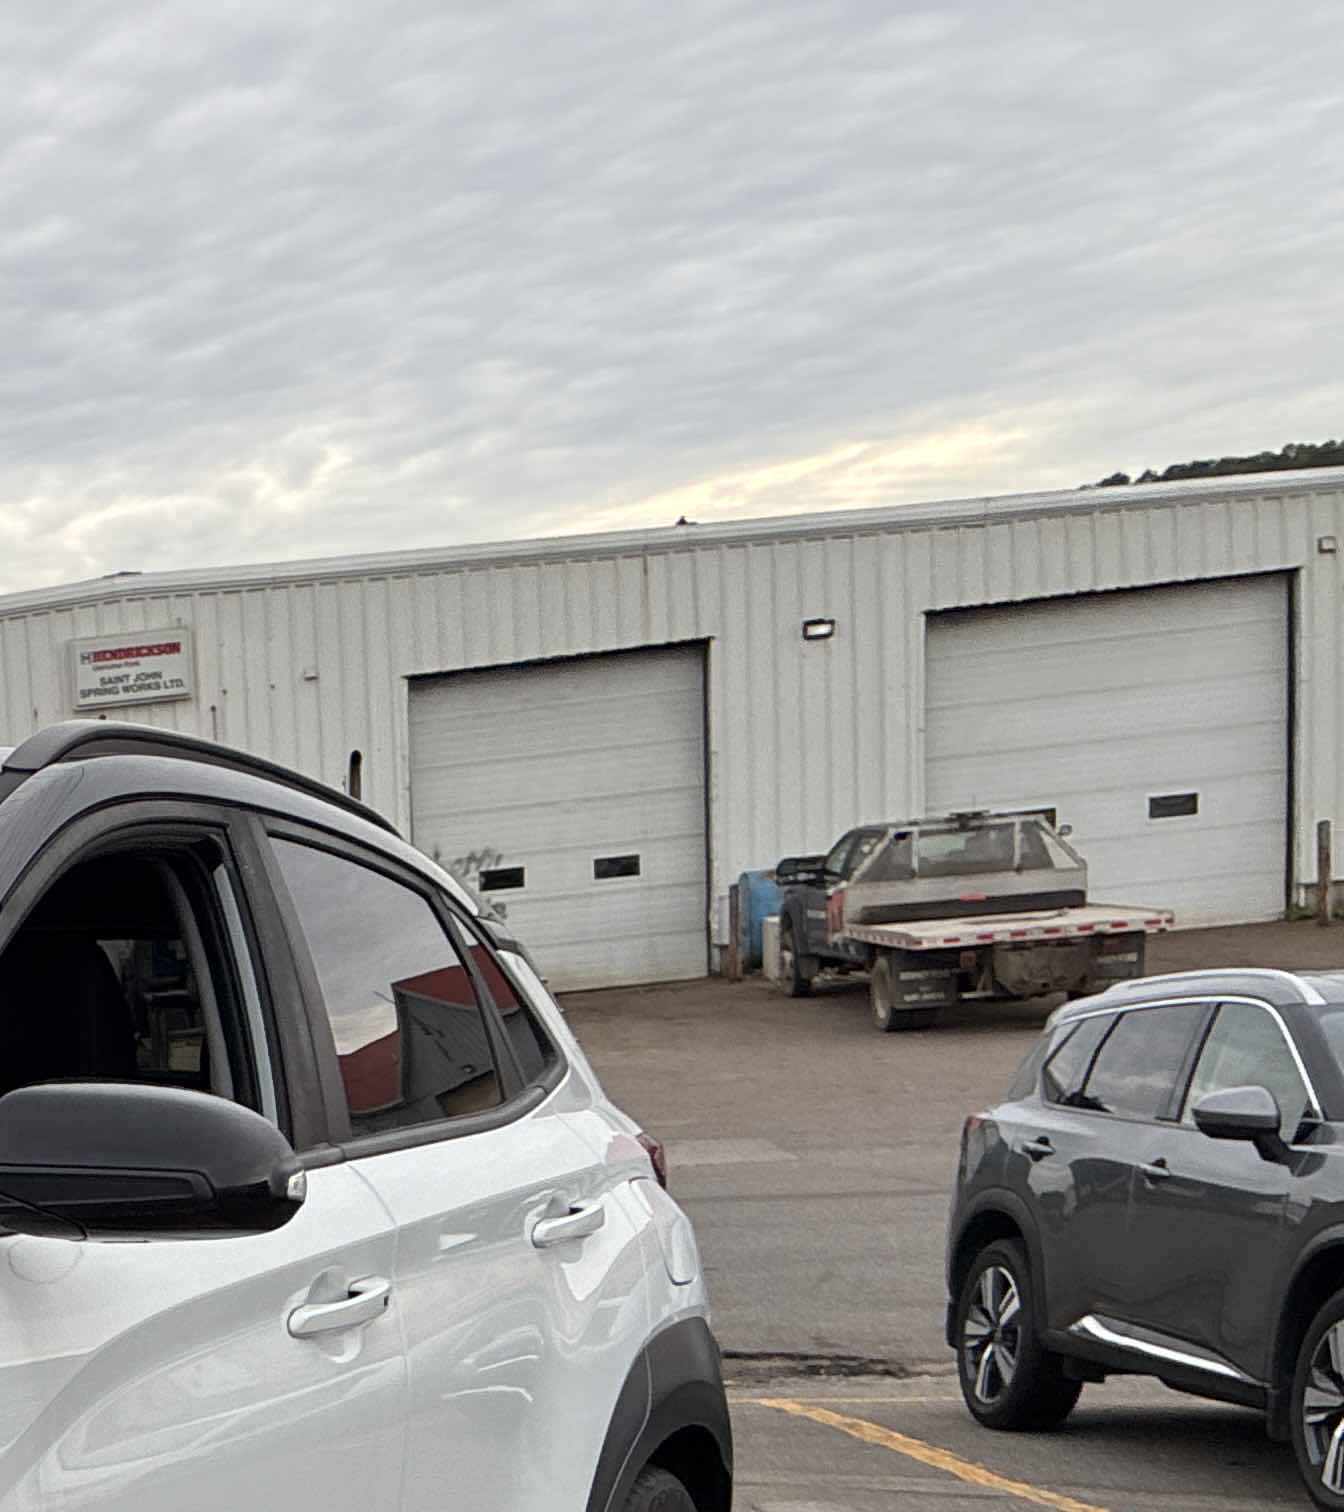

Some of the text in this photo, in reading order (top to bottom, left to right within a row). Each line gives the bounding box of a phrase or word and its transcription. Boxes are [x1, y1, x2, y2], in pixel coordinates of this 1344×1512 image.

[99, 671, 163, 686] SAINT JOHN
[80, 686, 119, 699] SPRING
[122, 680, 161, 693] WORKS
